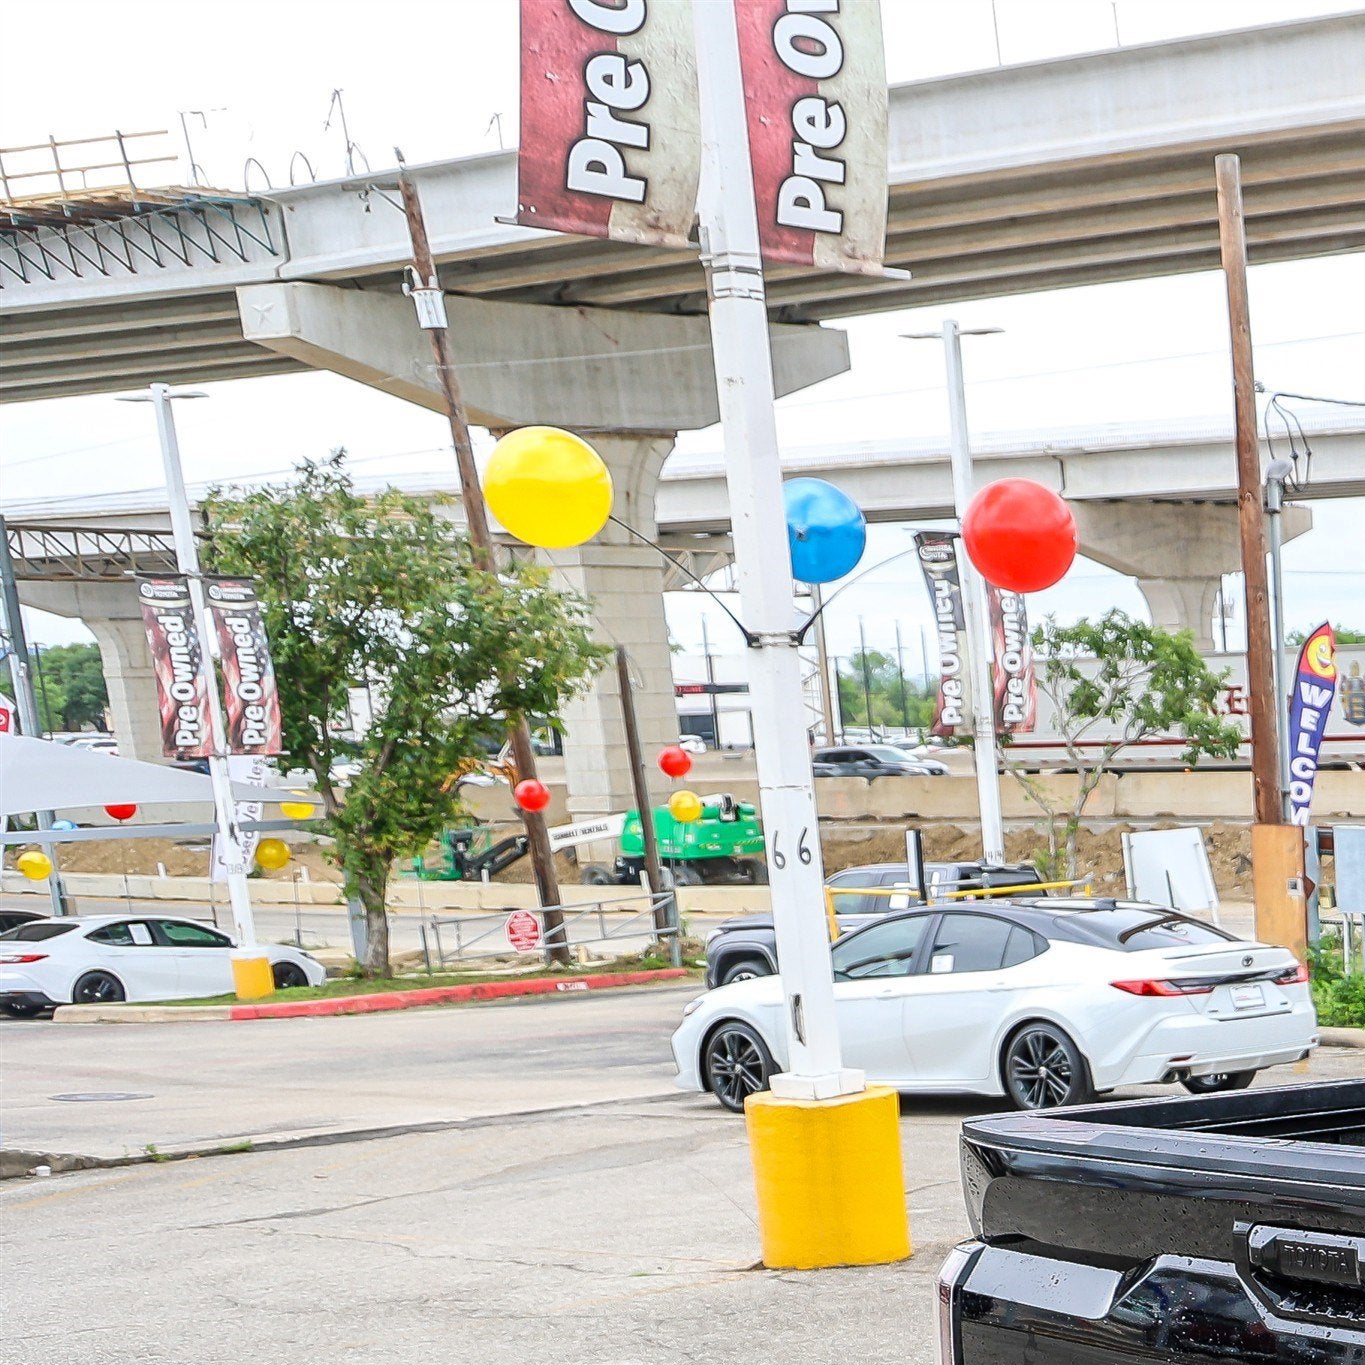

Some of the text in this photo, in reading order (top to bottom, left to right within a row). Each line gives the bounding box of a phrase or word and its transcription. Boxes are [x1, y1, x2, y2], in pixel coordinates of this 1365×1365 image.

[566, 52, 650, 203] Pre
[777, 97, 847, 235] Pre
[157, 615, 196, 702] Owned
[224, 616, 263, 702] Owned
[1001, 588, 1025, 723] Pre Owne
[174, 704, 201, 747] Pre
[242, 704, 267, 746] Pre
[940, 678, 963, 726] Pre
[1288, 681, 1333, 825] WELCOM
[1284, 1245, 1351, 1275] TOYOTA
